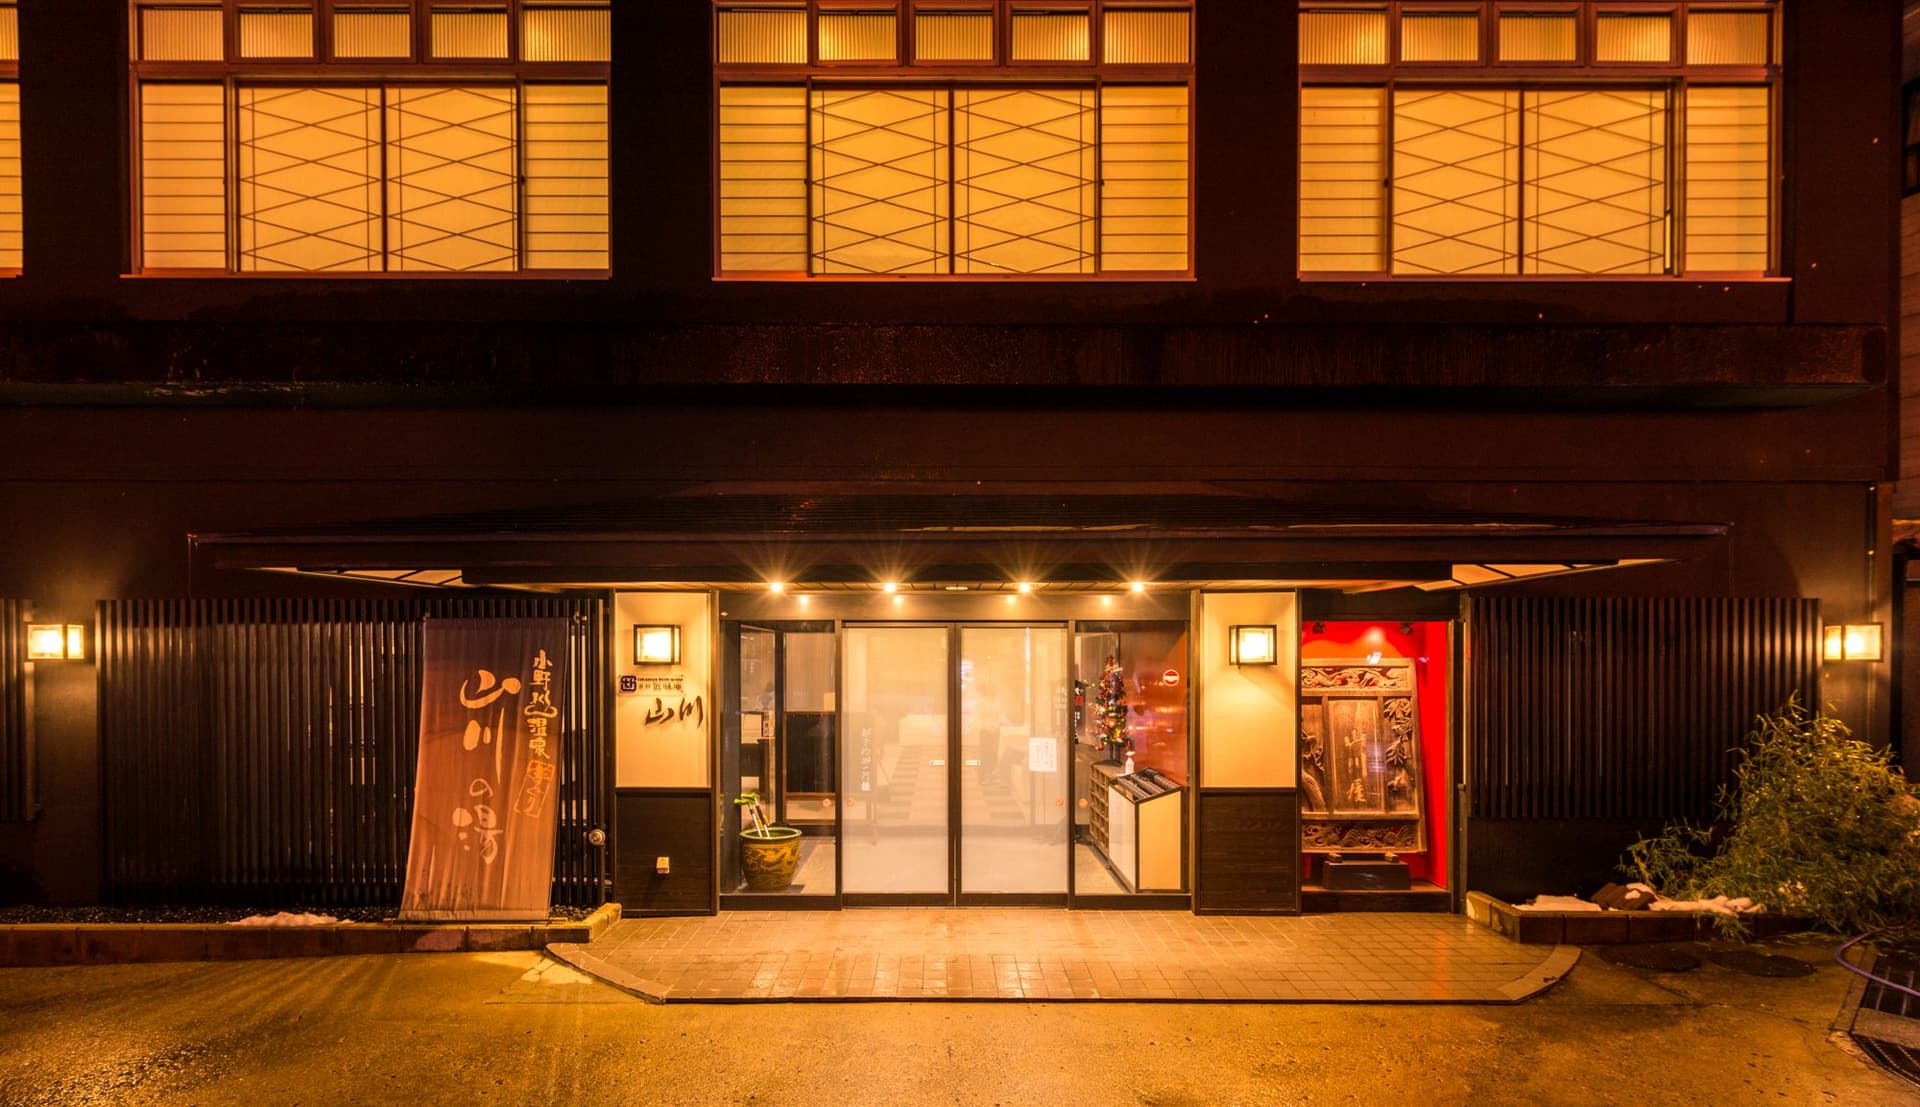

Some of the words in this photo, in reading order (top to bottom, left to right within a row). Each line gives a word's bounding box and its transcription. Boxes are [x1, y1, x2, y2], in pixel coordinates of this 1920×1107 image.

[524, 649, 558, 759] 小野川温泉
[644, 696, 704, 728] 山川
[452, 669, 522, 865] 山川の湯
